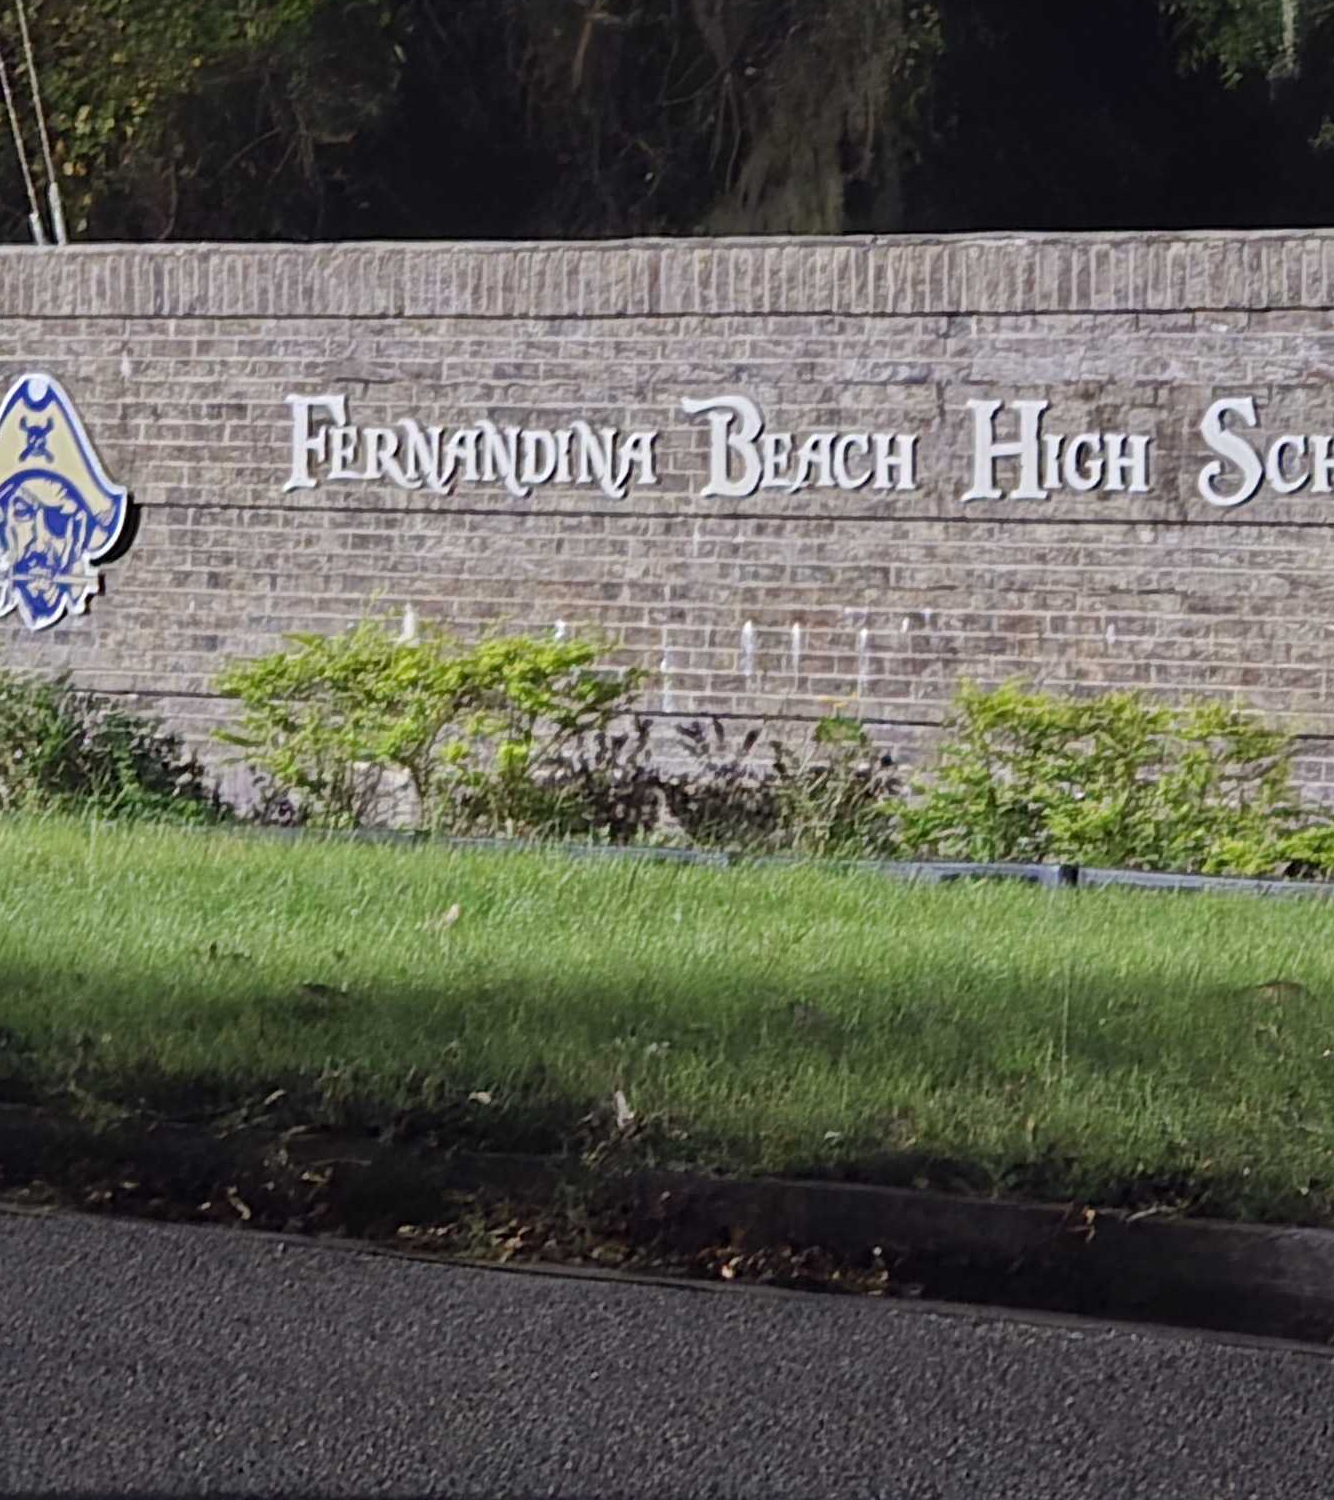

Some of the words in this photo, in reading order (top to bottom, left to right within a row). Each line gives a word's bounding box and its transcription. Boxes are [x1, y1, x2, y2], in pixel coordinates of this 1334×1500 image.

[283, 393, 657, 497] FERNANDINA
[681, 394, 918, 500] BEACH
[963, 399, 1152, 501] HIGH
